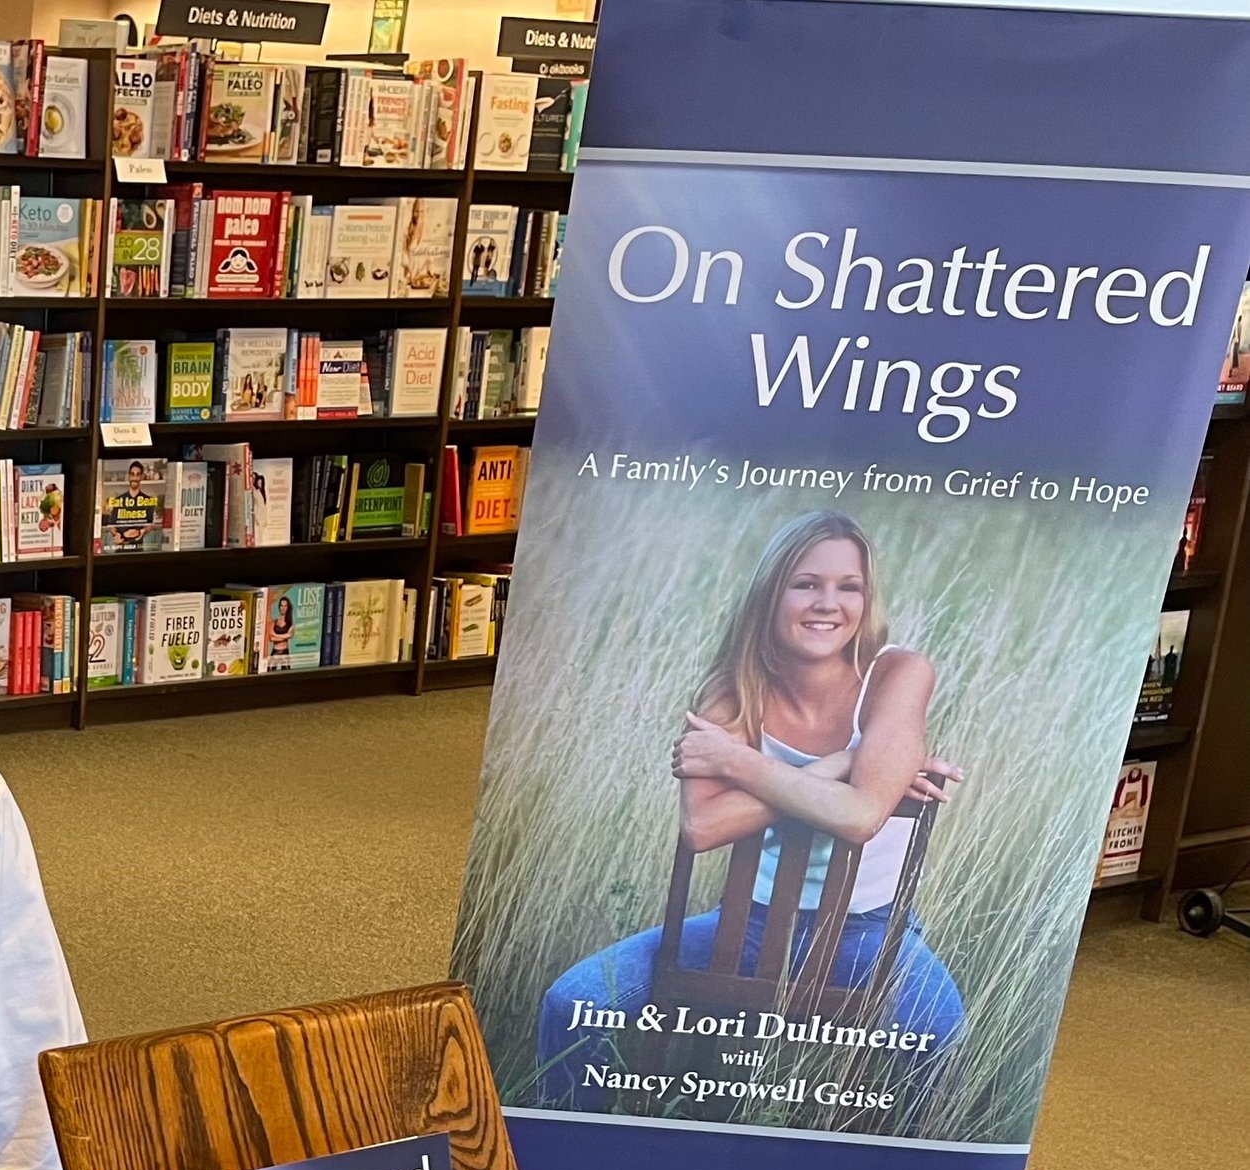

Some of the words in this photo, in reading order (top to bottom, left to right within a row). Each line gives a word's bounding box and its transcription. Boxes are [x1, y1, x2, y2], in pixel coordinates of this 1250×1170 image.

[188, 7, 223, 25] Diets
[226, 9, 238, 26] &
[241, 11, 296, 29] Nutrition
[525, 29, 555, 47] Diets
[558, 32, 569, 48] &
[571, 33, 596, 49] Nutr
[227, 79, 263, 91] PALEO
[490, 95, 529, 113] Fasting
[128, 163, 152, 174] Paleo
[19, 203, 51, 221] Keto
[217, 196, 244, 215] nom
[245, 197, 271, 215] nom
[224, 215, 259, 239] paleo
[133, 237, 160, 261] 28
[606, 224, 744, 307] On
[773, 228, 1212, 329] Shattered
[407, 346, 435, 361] Acid
[174, 361, 211, 375] BRAIN
[343, 362, 360, 372] Diet
[406, 370, 432, 385] Diet
[173, 382, 210, 397] BODY
[749, 332, 1021, 444] Wings
[578, 454, 600, 478] A
[611, 452, 729, 485] Family's
[736, 458, 854, 498] Journey
[861, 463, 933, 494] from
[943, 469, 1019, 500] Grief
[1029, 475, 1060, 501] to
[1069, 475, 1149, 508] Hope
[109, 497, 123, 507] Eat
[125, 497, 134, 506] to
[137, 496, 158, 506] Beat
[475, 499, 511, 520] DIET
[21, 511, 39, 524] KETO
[117, 508, 147, 520] Illness
[184, 508, 204, 517] DIET
[297, 587, 323, 606] LOSE
[296, 606, 320, 618] WEIGHT
[166, 616, 195, 631] FIBER
[212, 618, 243, 630] OODS
[161, 631, 200, 647] FUELED
[1109, 837, 1138, 849] FRONT
[567, 999, 627, 1033] Jim
[635, 1002, 668, 1033] &
[676, 1005, 746, 1039] Lori
[754, 1011, 936, 1053] Dultmeier
[720, 1047, 764, 1068] with
[582, 1064, 675, 1098] Nancy
[680, 1071, 808, 1104] Sprowell
[813, 1082, 895, 1110] Geise
